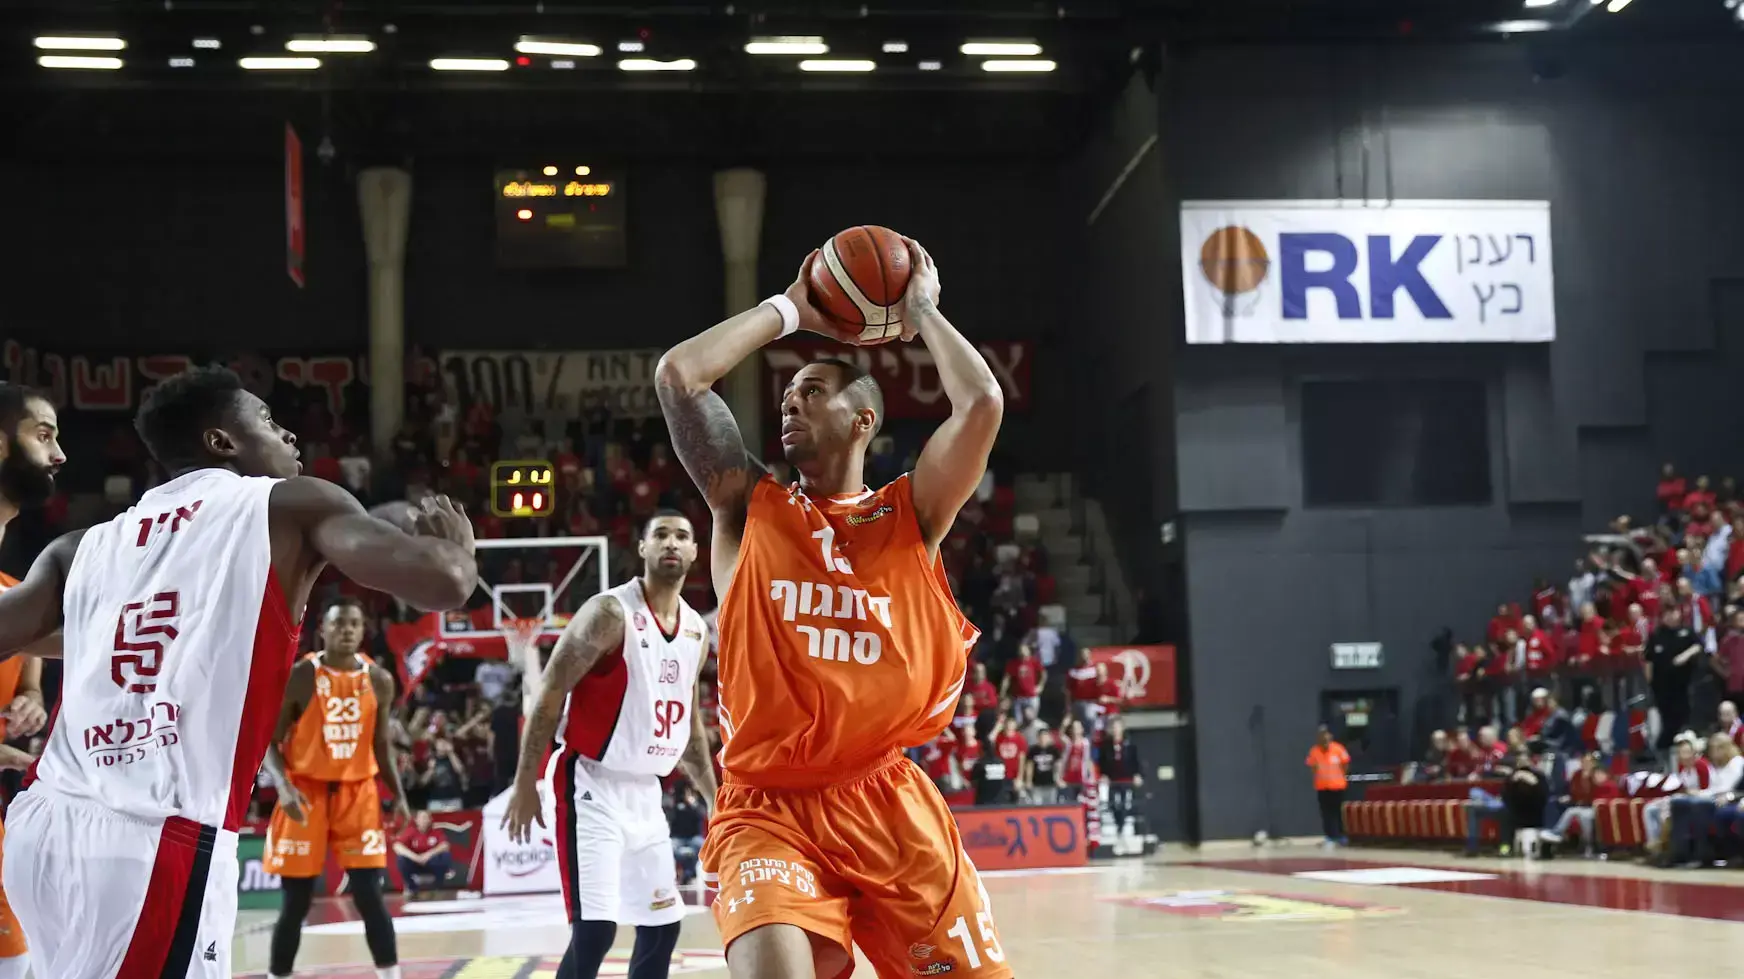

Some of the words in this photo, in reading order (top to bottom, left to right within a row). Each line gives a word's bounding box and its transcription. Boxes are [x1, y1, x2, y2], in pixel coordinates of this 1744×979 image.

[1455, 233, 1536, 274] רענן
[1278, 232, 1454, 319] RK
[1473, 284, 1524, 324] כץ
[796, 624, 882, 666] סחר
[326, 696, 362, 723] 23
[653, 699, 685, 740] SP
[739, 867, 791, 887] ציונה
[947, 911, 1005, 970] 15
